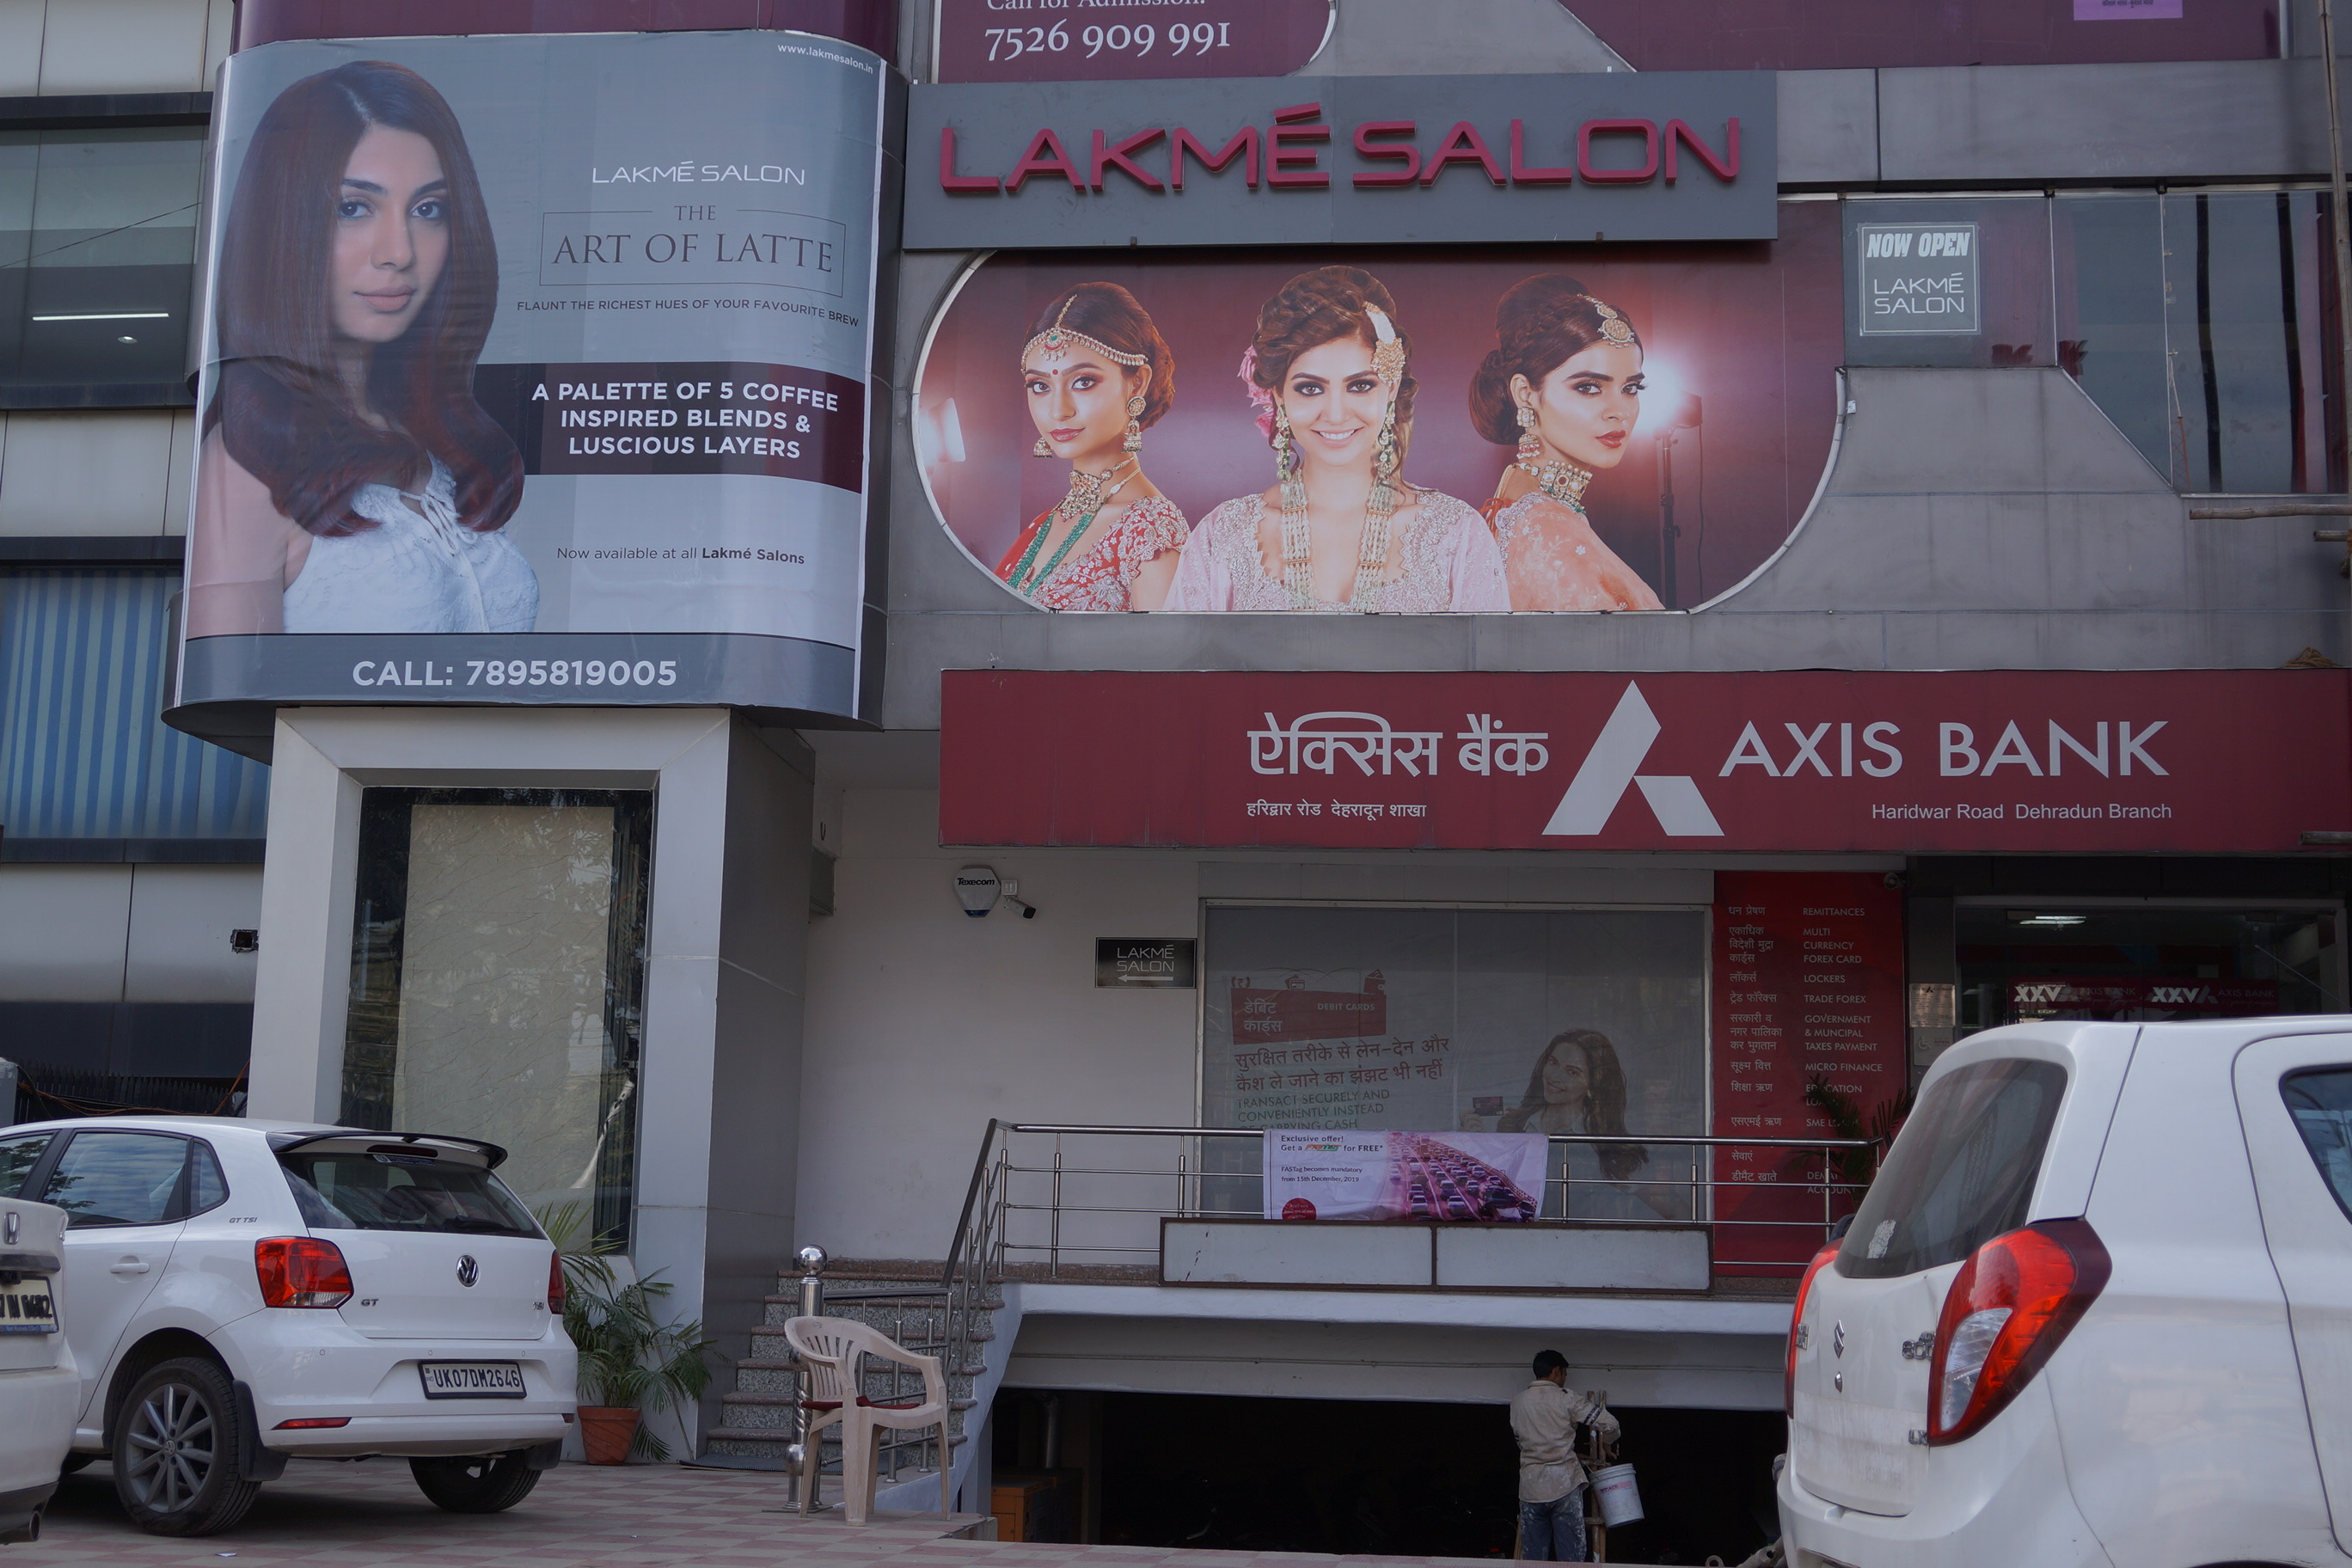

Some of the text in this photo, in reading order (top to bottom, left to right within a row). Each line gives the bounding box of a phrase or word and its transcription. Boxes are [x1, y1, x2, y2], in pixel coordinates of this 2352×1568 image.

[984, 18, 1231, 62] 7526 909 991
[777, 43, 874, 75] www.lakmesalon.in
[939, 101, 1740, 193] LAKMÉ SALON
[591, 161, 805, 186] LAKMÉ SALON
[674, 205, 716, 221] THE
[551, 233, 833, 273] ART OF LATTE
[1866, 232, 1970, 258] NOW OPEN
[1874, 273, 1964, 294] LAKMÉ
[517, 299, 860, 327] FLAUNT THE RICHEST HUES OF YOUR FAVOURITE BREW
[1874, 297, 1964, 315] SALON
[531, 382, 838, 412] A PALETTE OF 5 COFFEE
[561, 408, 811, 433] INSPIRED BLENDS &
[569, 436, 800, 459] LUSCIOUS LAYERS
[556, 546, 805, 565] Now available at all Lakmé Salons
[352, 659, 677, 686] CALL: 7895819005
[1246, 711, 1549, 777] ऐक्सिस बैंक
[1718, 718, 2171, 779] AXIS BANK
[1246, 798, 1427, 821] हरिद्वार रोड देहरादून शाखा
[1871, 803, 2172, 819] Haridwar Road Dehradun Branch
[1803, 908, 1865, 916] REMITTANCES
[1803, 928, 1831, 936] MULTI
[1118, 945, 1174, 959] LAKMÉ
[1729, 937, 1755, 950] विदेशी
[1804, 941, 1854, 950] CURRENCY
[1117, 960, 1174, 972] SALON
[1835, 955, 1862, 964] CARD
[1836, 995, 1866, 1003] FOREX
[2218, 989, 2242, 997] AXIS
[2245, 989, 2275, 998] BANK
[1243, 997, 1277, 1014] डेबिट
[1317, 1002, 1375, 1011] DEBIT CARDS
[1730, 1012, 1762, 1022] सरकारी
[1804, 1014, 1871, 1023] GOVERNMENT
[1730, 1025, 1783, 1037] नगर पालिका
[1234, 1047, 1287, 1072] सुरक्षित
[1291, 1043, 1332, 1063] तरीके
[1337, 1041, 1352, 1059] से
[1421, 1033, 1450, 1053] और
[1730, 1041, 1777, 1053] कर भुगतान
[1804, 1042, 1877, 1051] TAXES PAYMENT
[1235, 1057, 1444, 1093] कैश ले जाने का झंझट भी नहीं
[1805, 1063, 1883, 1072] MICRO FINANCE
[1237, 1089, 1390, 1109] TRANSACT SECURELY AND
[1238, 1103, 1385, 1123] CONVENIENTLY INSTEAD
[1325, 1118, 1358, 1130] CASH
[1806, 1118, 1826, 1127] SME
[361, 1298, 379, 1307] GT
[433, 1369, 520, 1387] UK07DM2646
